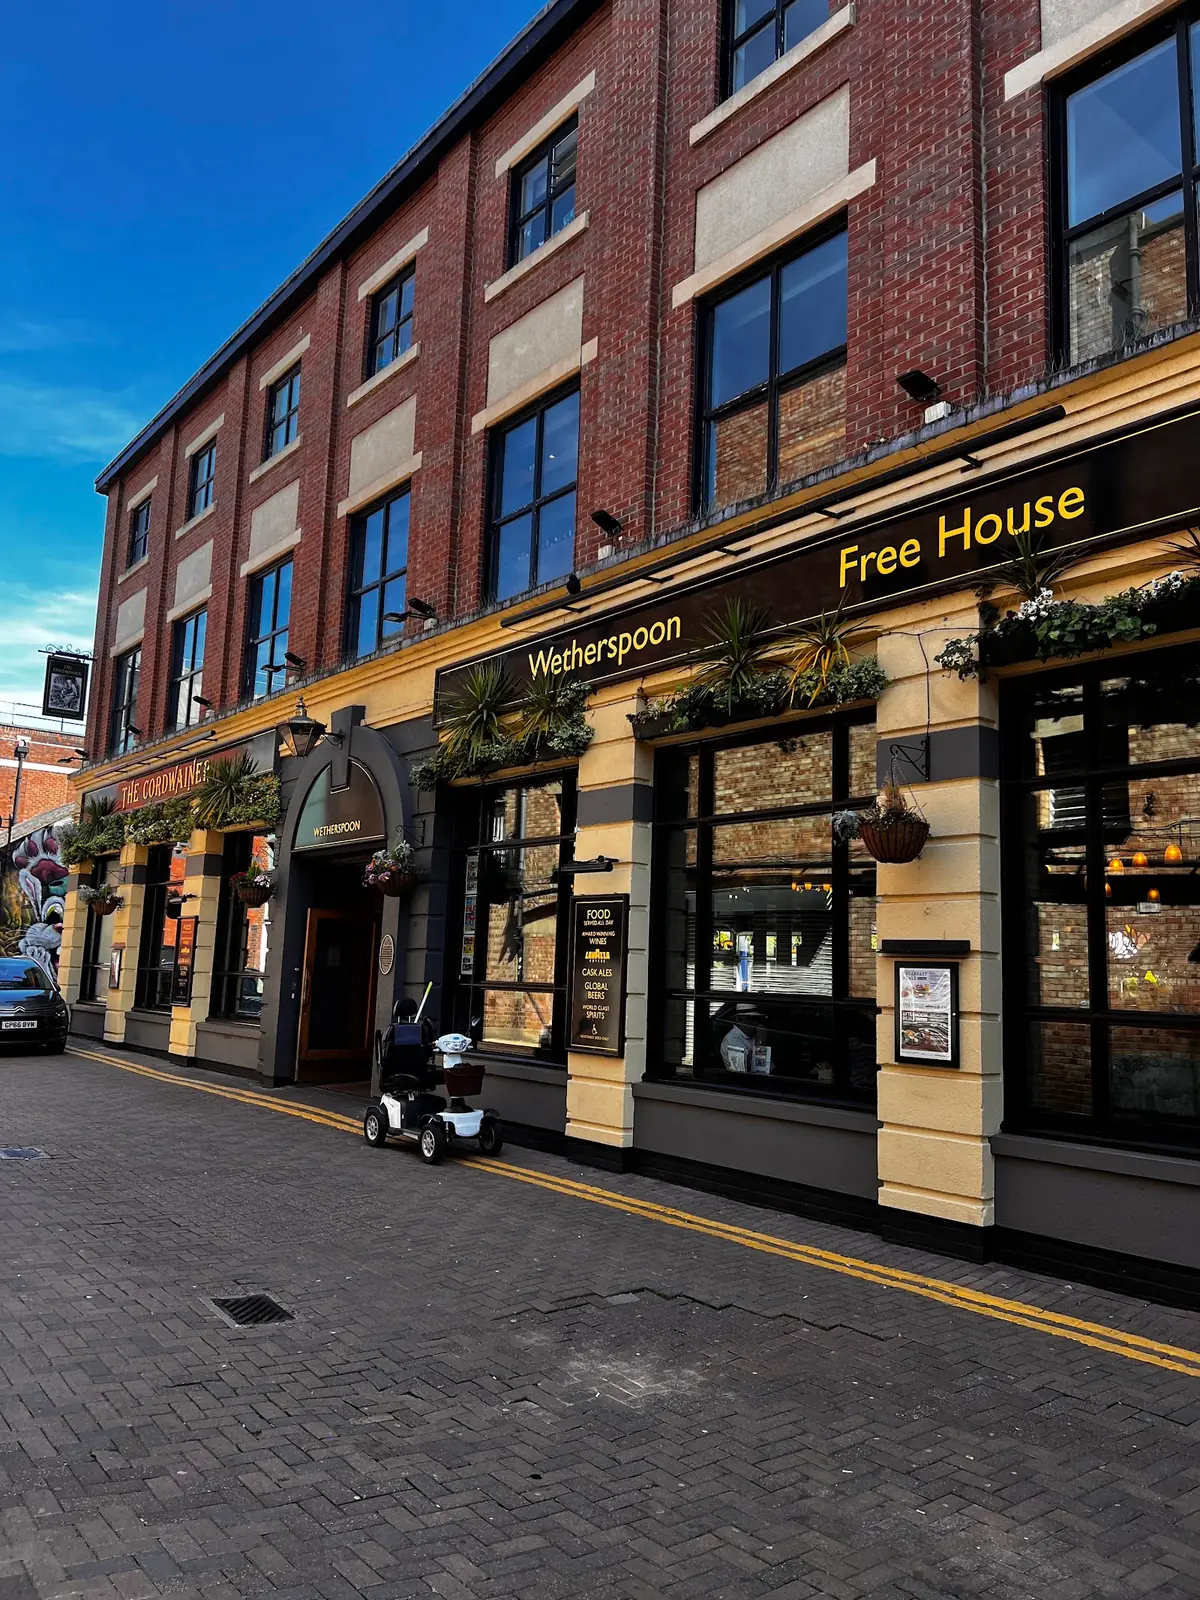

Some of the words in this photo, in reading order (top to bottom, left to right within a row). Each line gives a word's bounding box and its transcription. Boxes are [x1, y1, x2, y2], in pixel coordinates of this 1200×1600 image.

[839, 538, 921, 588] Free
[938, 486, 1085, 557] House
[528, 615, 681, 681] Wetherspoon
[121, 779, 140, 809] THE
[313, 820, 361, 837] WETHERSPOON
[587, 909, 610, 919] FOOD
[589, 937, 607, 945] WINES
[581, 968, 598, 977] CASK
[598, 968, 613, 977] ALES
[584, 981, 609, 991] GLOBAL
[587, 991, 605, 1000] BEERS
[586, 1010, 605, 1020] SPIRITS
